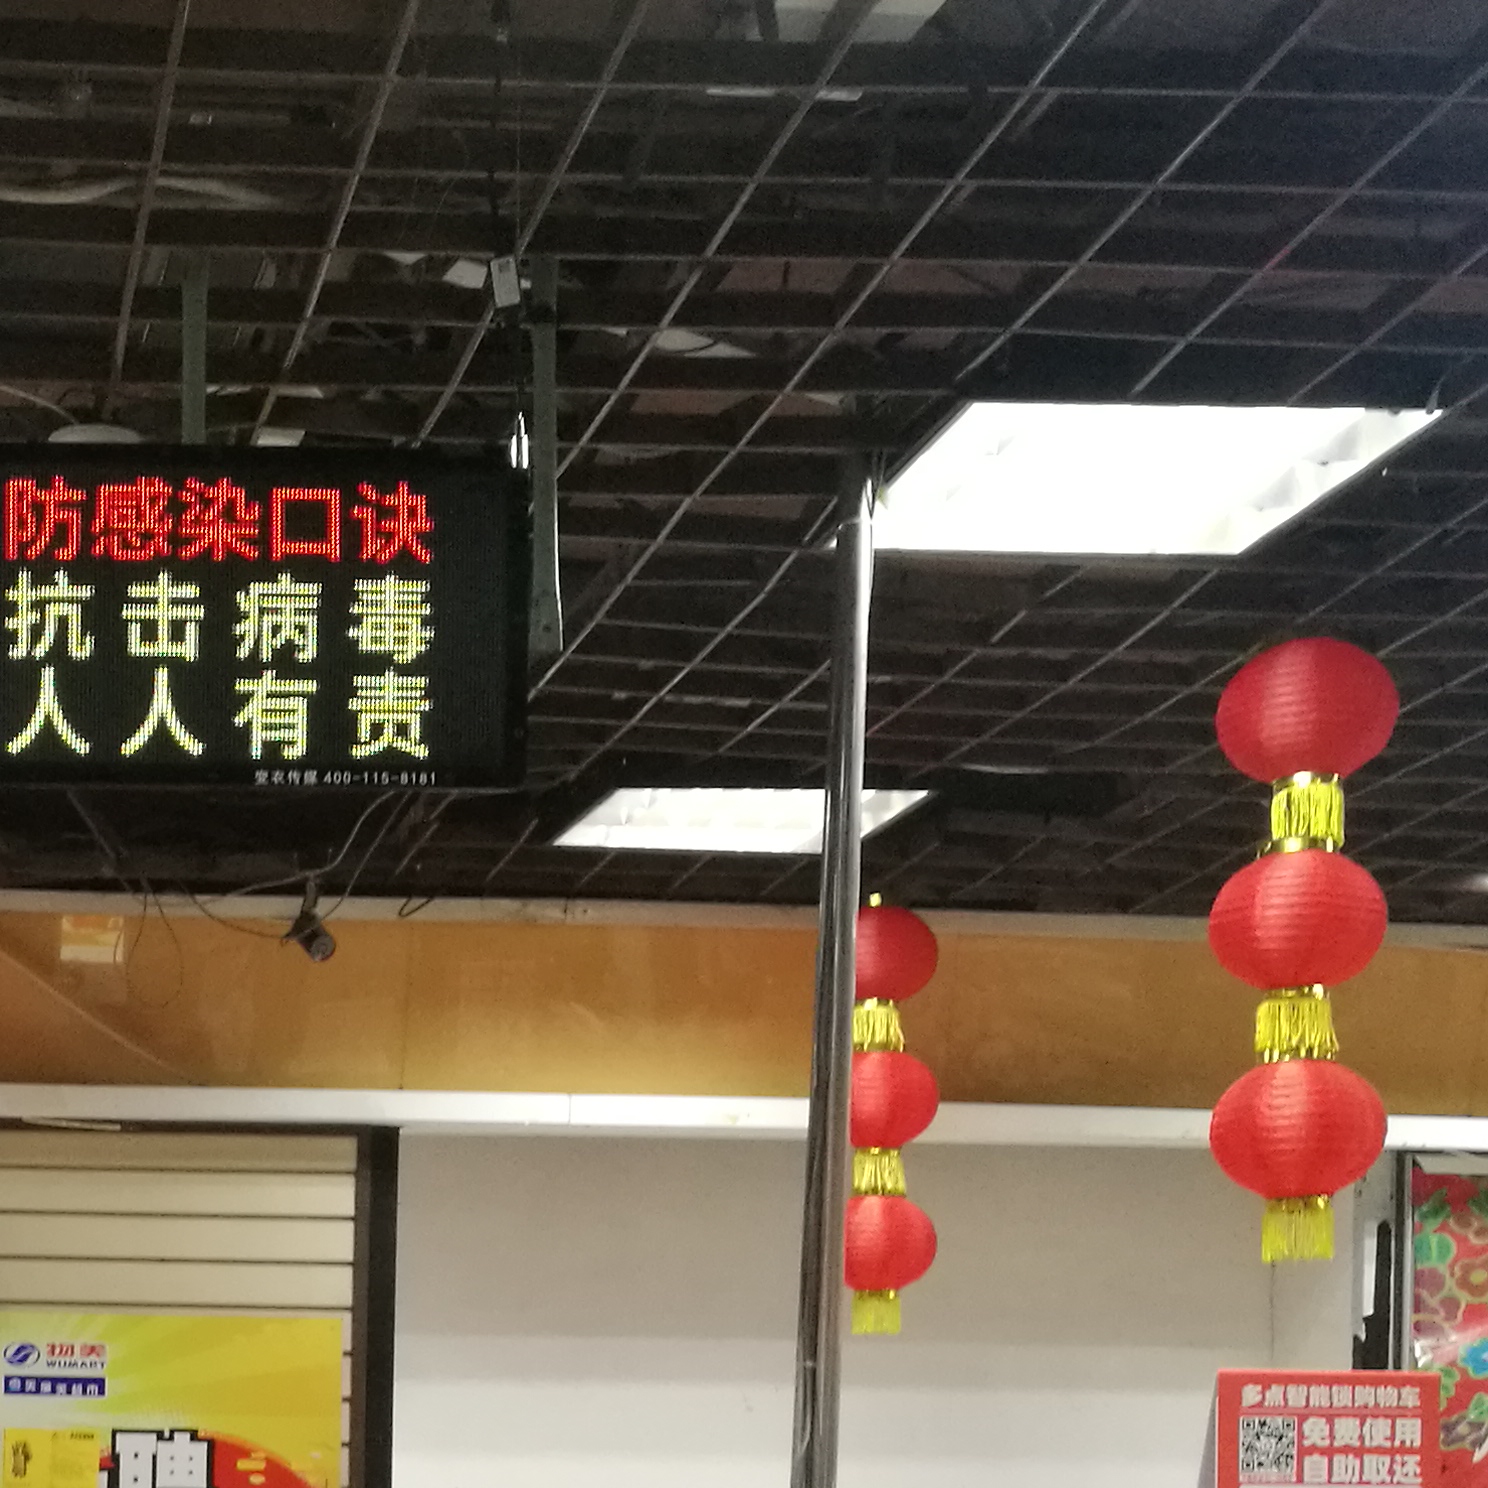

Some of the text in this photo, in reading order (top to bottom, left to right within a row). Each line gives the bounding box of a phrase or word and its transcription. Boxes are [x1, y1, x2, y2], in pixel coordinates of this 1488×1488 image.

[2, 475, 435, 563] 防感染口诀
[5, 568, 435, 663] 抗击病毒
[6, 666, 432, 760] 人人有责
[1302, 1416, 1423, 1448] 免费使用
[1303, 1453, 1423, 1485] 自助取还
